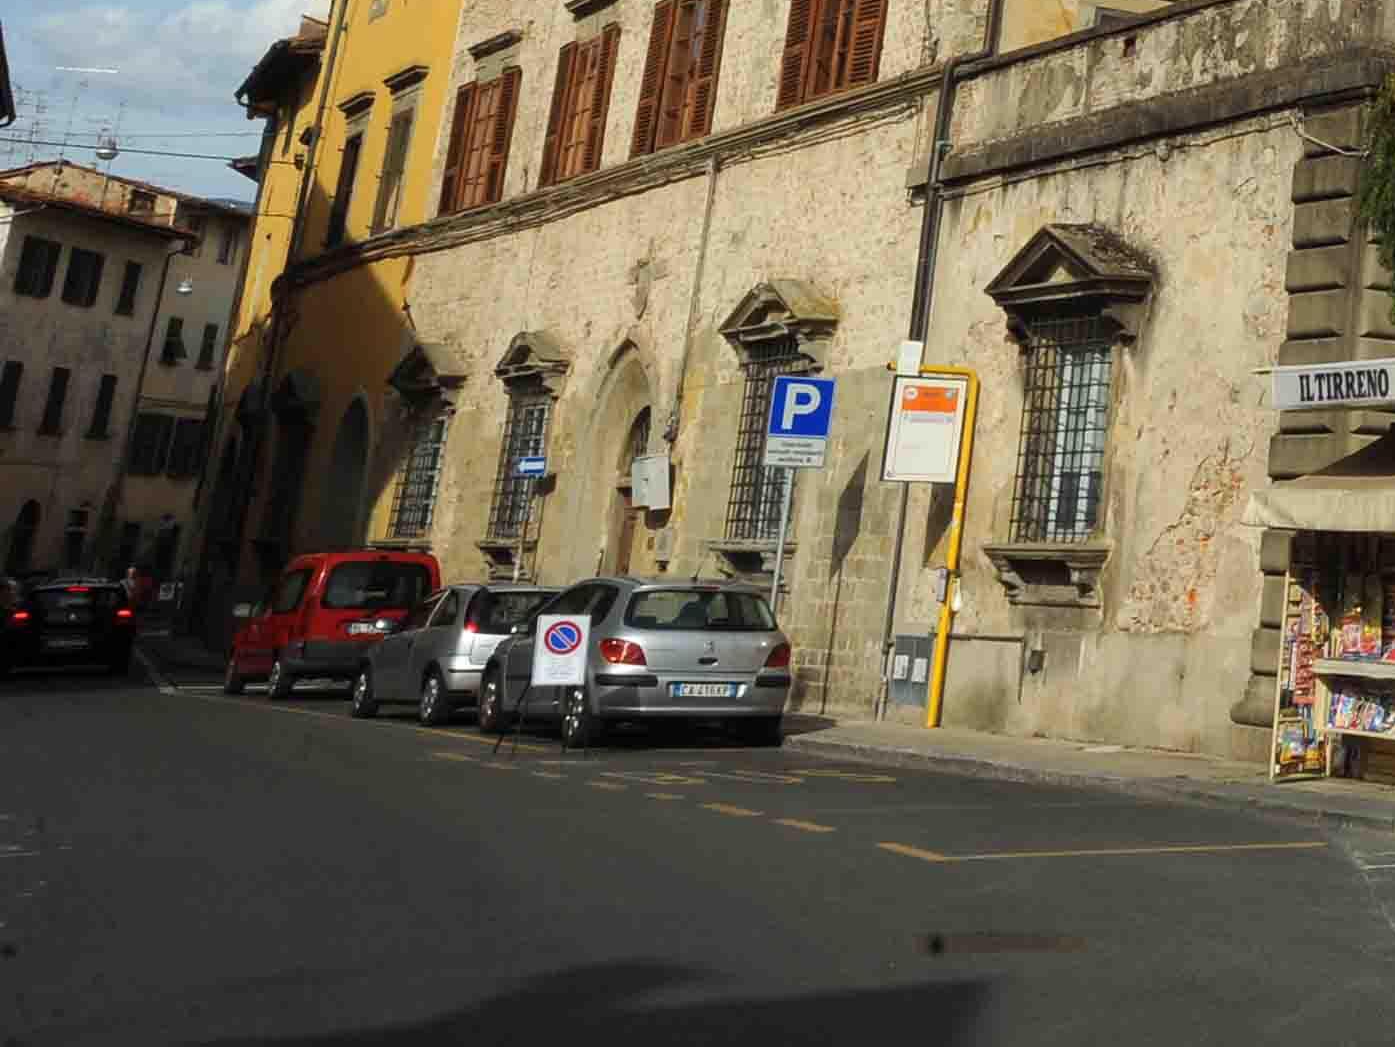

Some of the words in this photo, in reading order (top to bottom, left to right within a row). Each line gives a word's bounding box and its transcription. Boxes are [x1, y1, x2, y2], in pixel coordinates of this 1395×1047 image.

[1298, 374, 1315, 402] IL
[1314, 368, 1390, 401] TIRRENO
[781, 383, 821, 430] P
